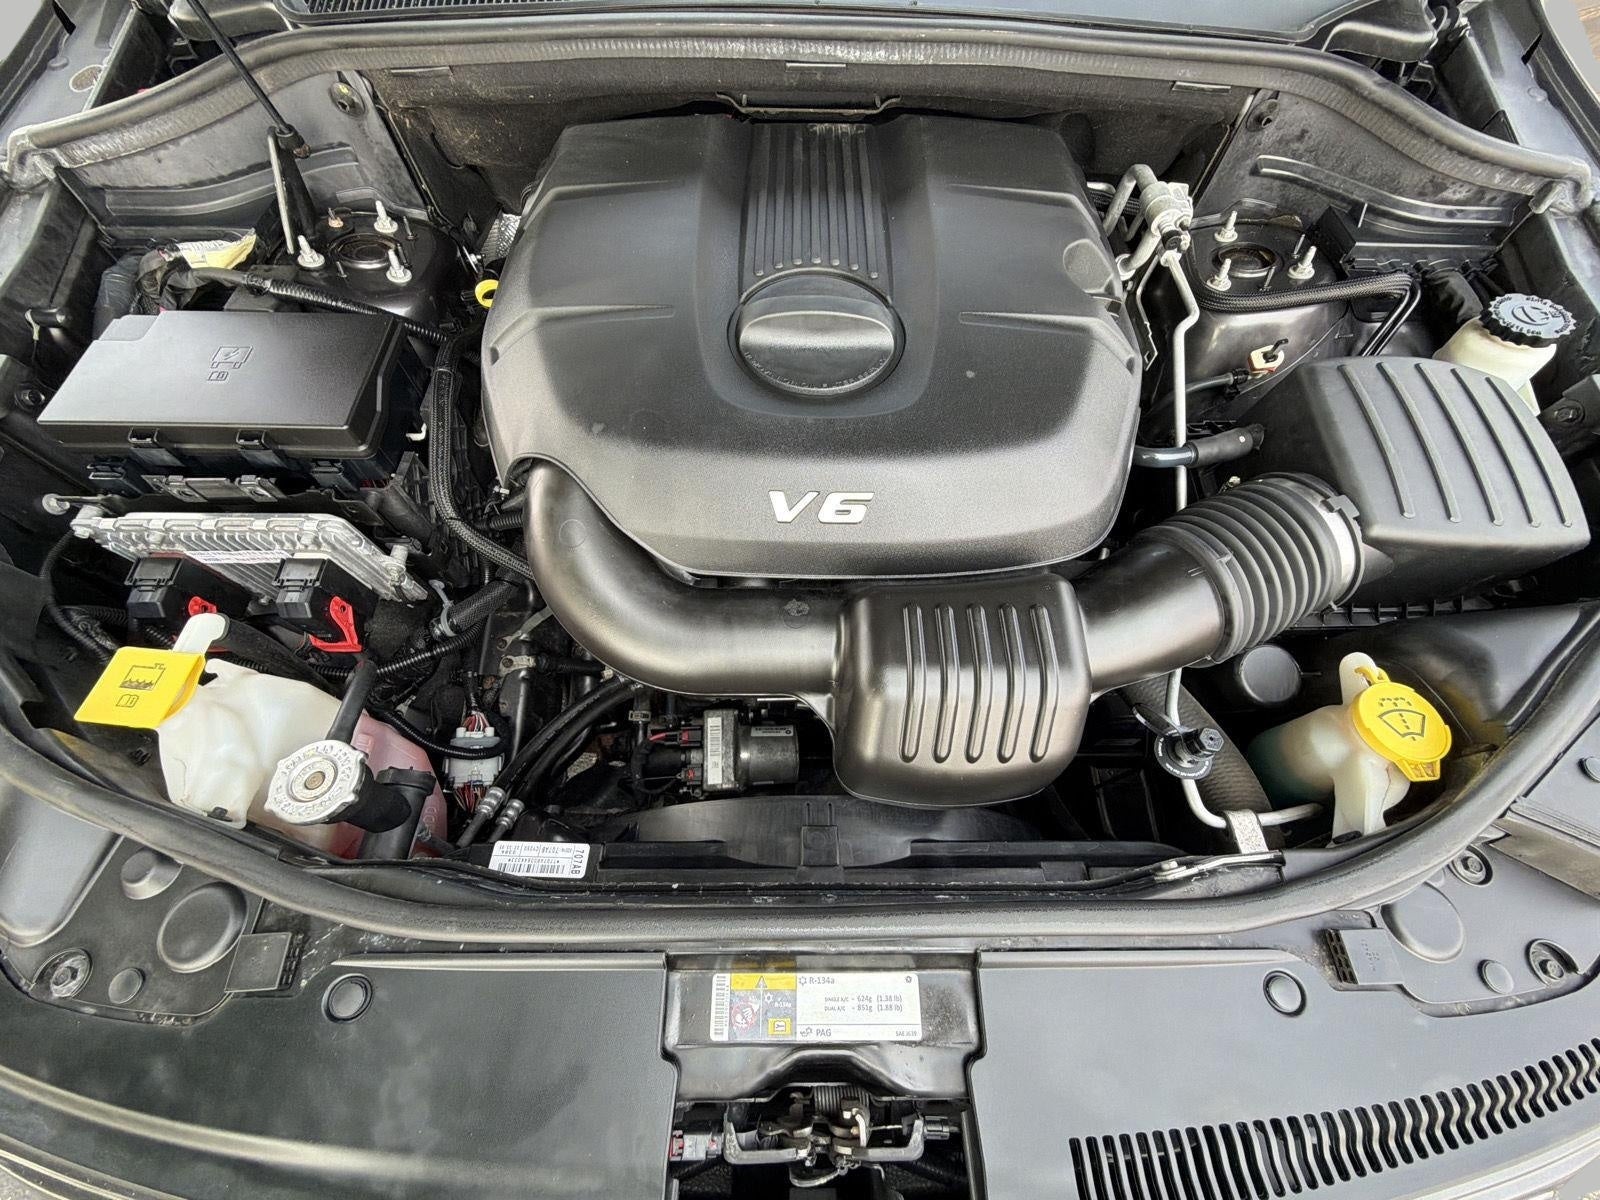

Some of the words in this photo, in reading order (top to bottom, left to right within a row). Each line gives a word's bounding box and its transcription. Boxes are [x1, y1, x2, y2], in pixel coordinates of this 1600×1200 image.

[768, 490, 875, 525] V6
[571, 849, 585, 875] 707AB
[809, 976, 835, 985] R-134a
[857, 995, 873, 1004] 624g
[857, 1004, 873, 1013] 851g
[816, 1028, 832, 1037] PAG
